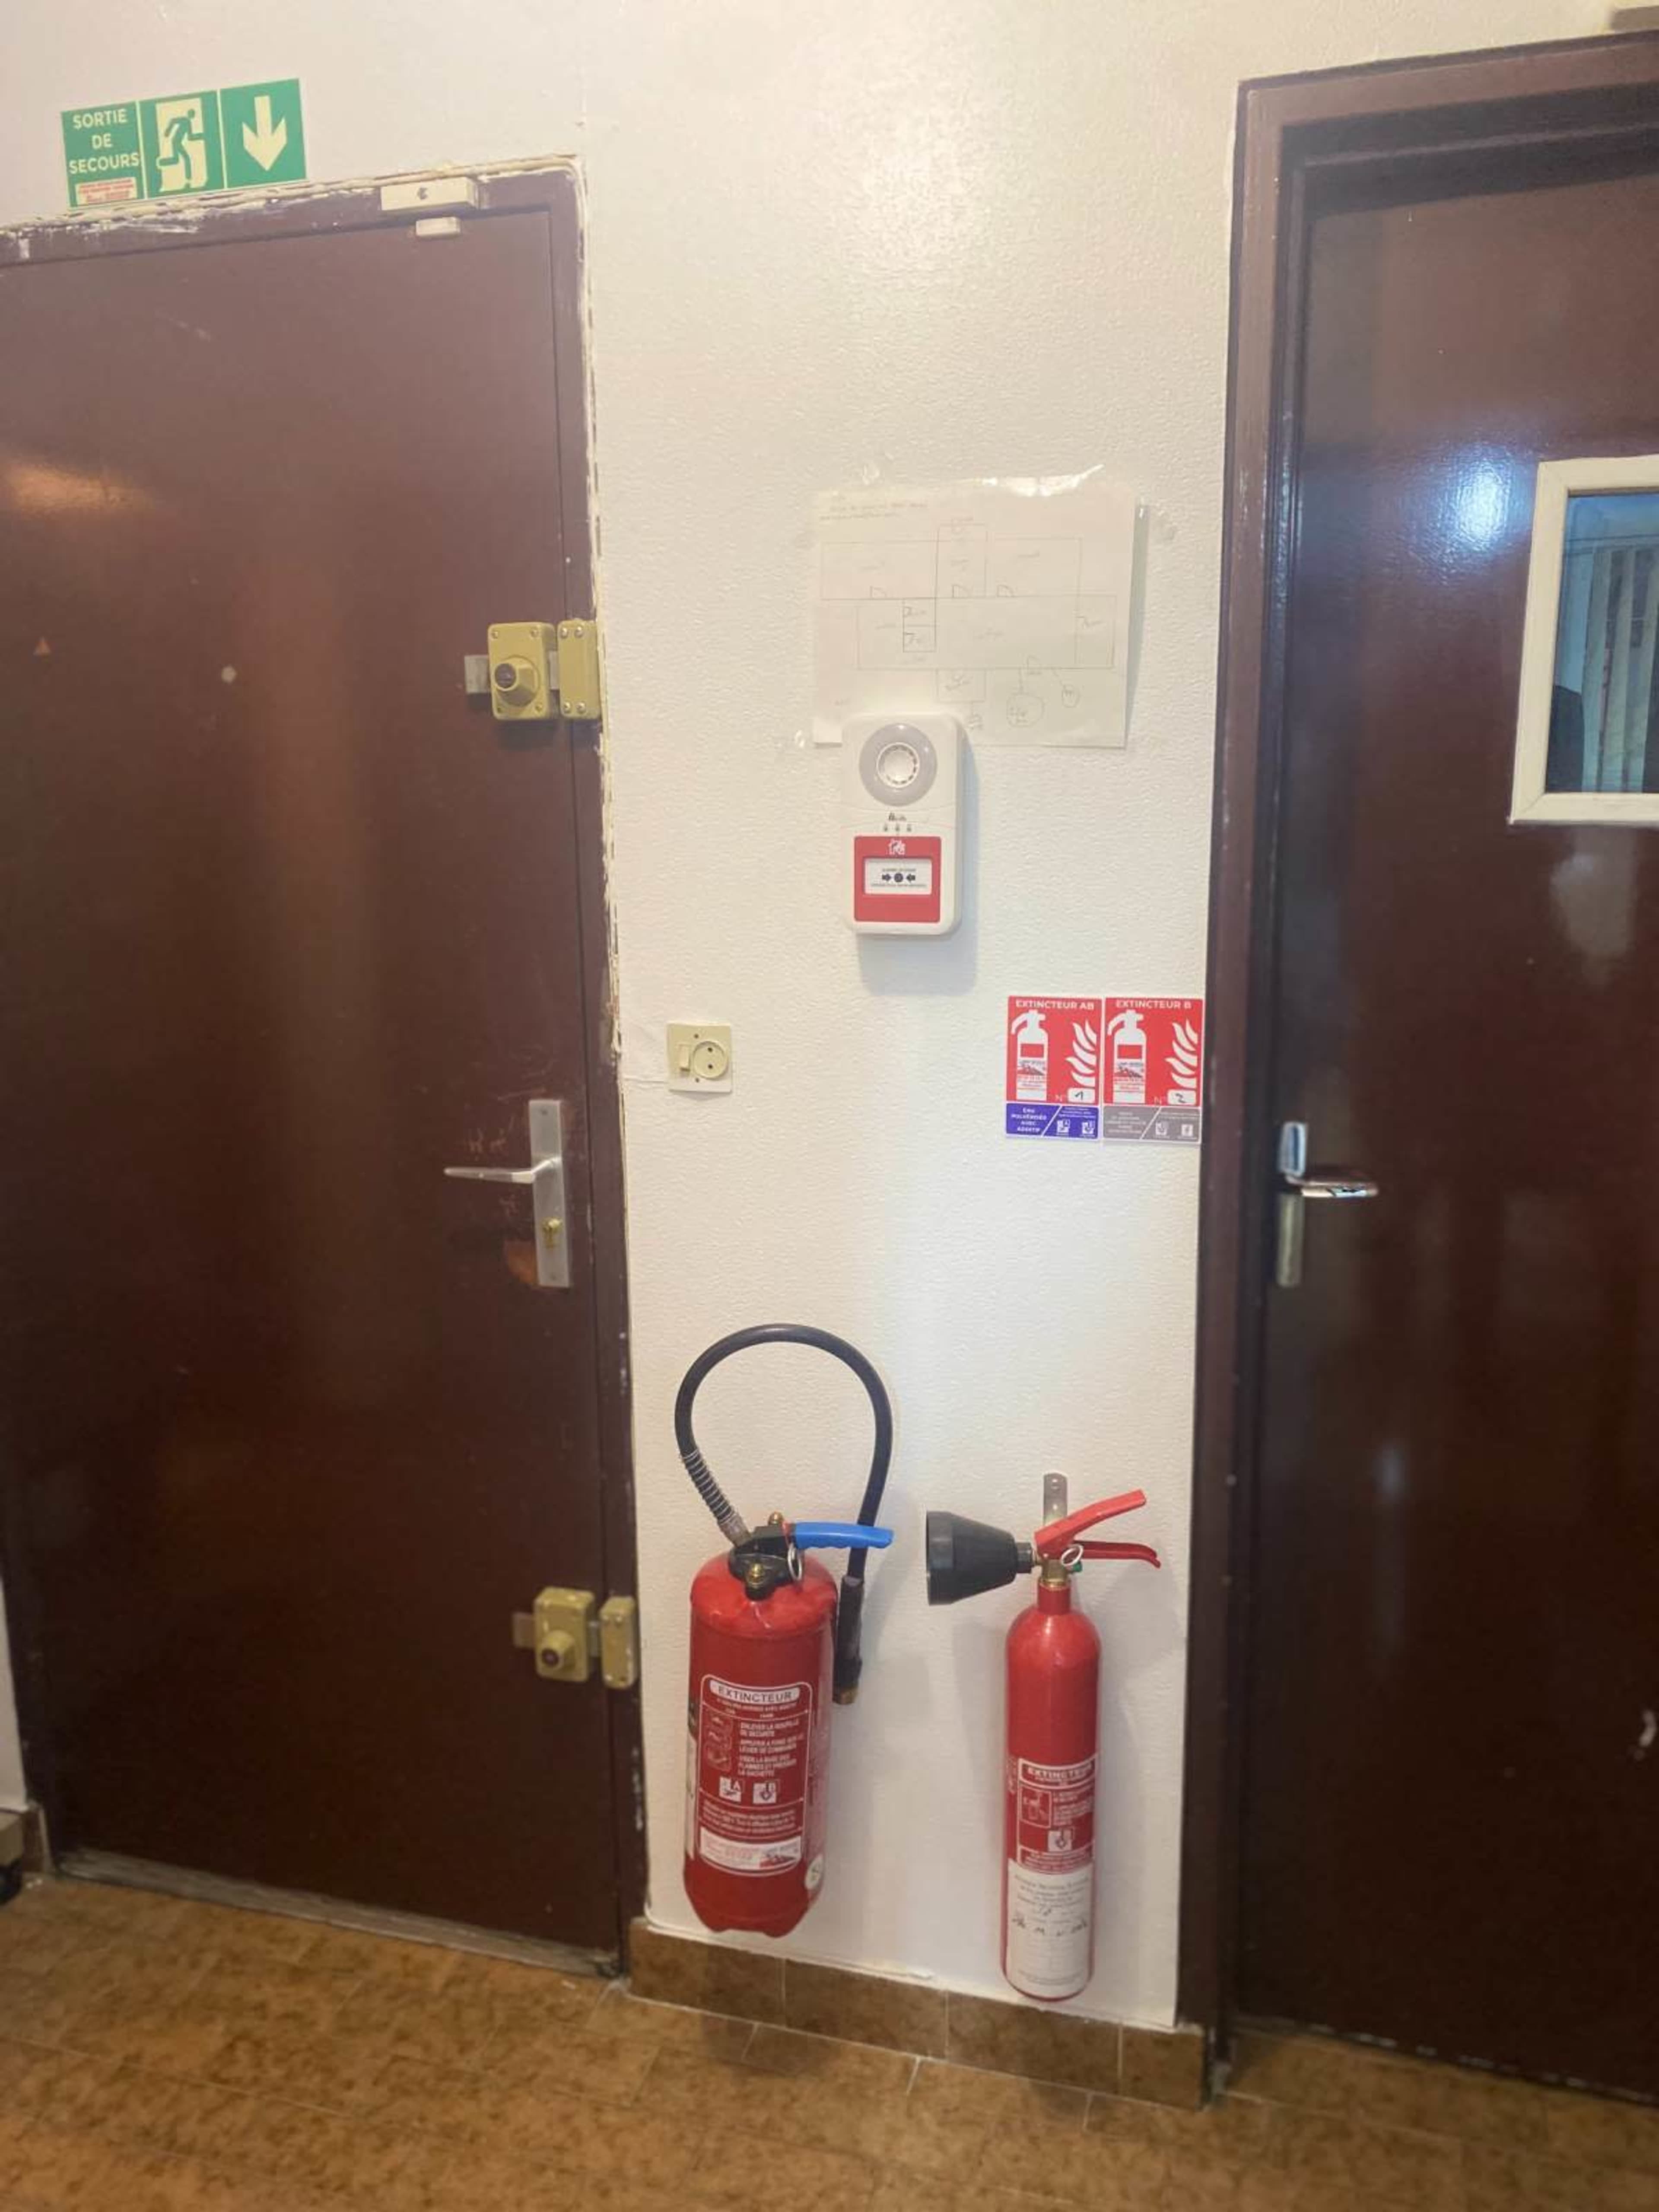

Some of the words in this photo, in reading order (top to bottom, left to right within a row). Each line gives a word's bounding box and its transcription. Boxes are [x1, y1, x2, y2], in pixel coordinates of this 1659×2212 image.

[73, 109, 128, 129] SORTIE
[92, 133, 113, 149] DE
[69, 153, 140, 174] SECOURS
[1016, 1000, 1077, 1009] EXTINCTEUR
[1080, 1002, 1094, 1010] AB
[1116, 999, 1181, 1008] EXTINCTEUR
[1184, 1001, 1192, 1009] B
[718, 1685, 791, 1703] EXTINCTEUR
